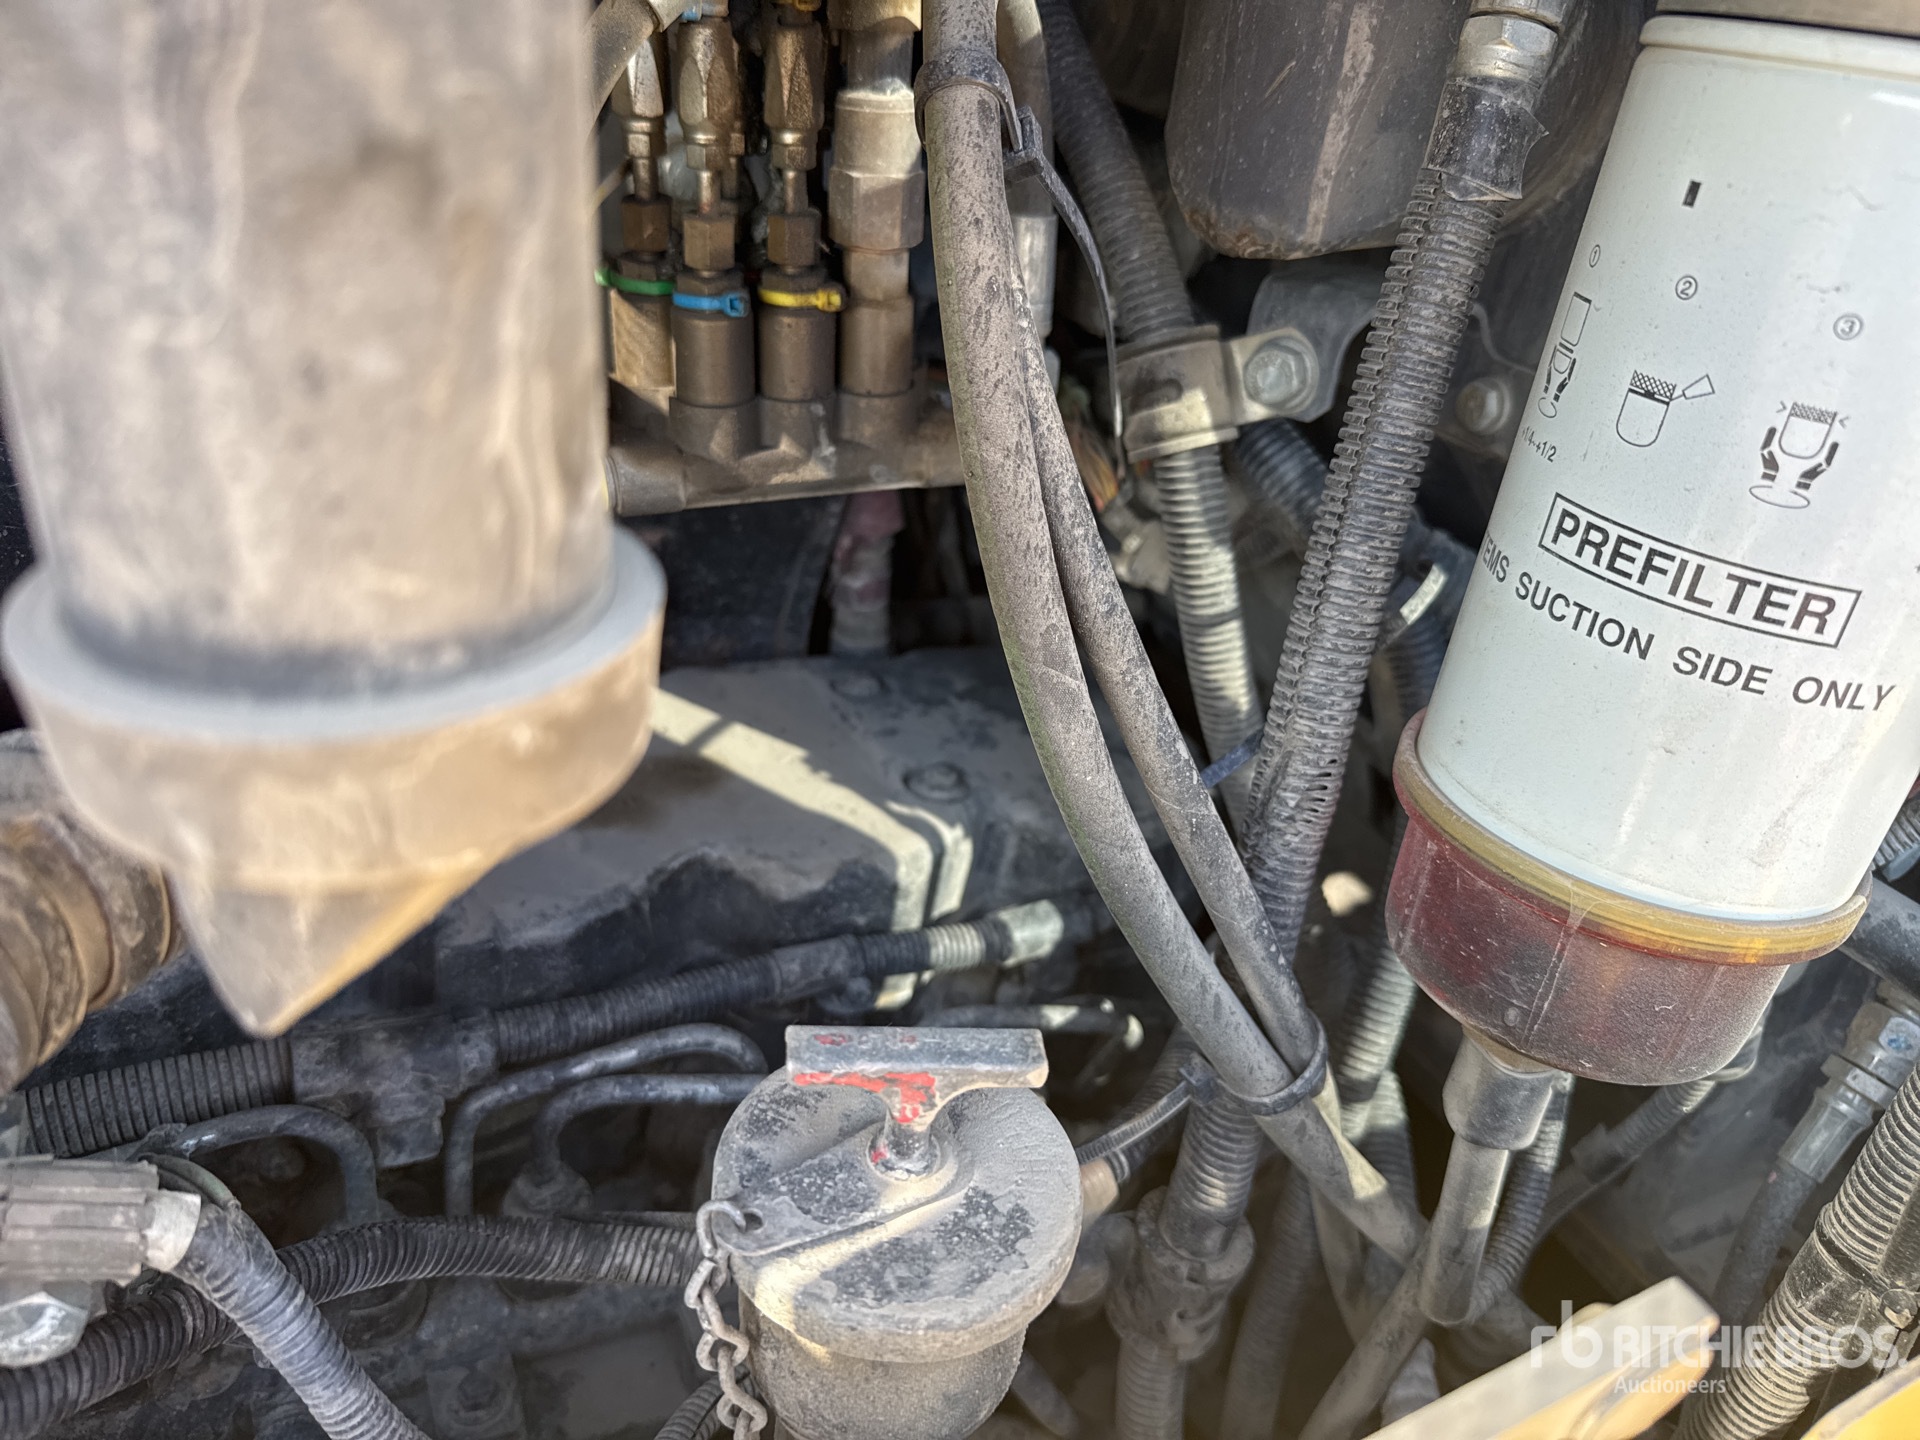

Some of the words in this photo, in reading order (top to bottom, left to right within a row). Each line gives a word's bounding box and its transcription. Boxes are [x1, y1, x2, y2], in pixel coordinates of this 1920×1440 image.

[1550, 507, 1837, 636] PREFILTER
[1515, 571, 1655, 660] SUCTION
[1672, 646, 1773, 696] SIDE
[1792, 676, 1896, 712] ONLY
